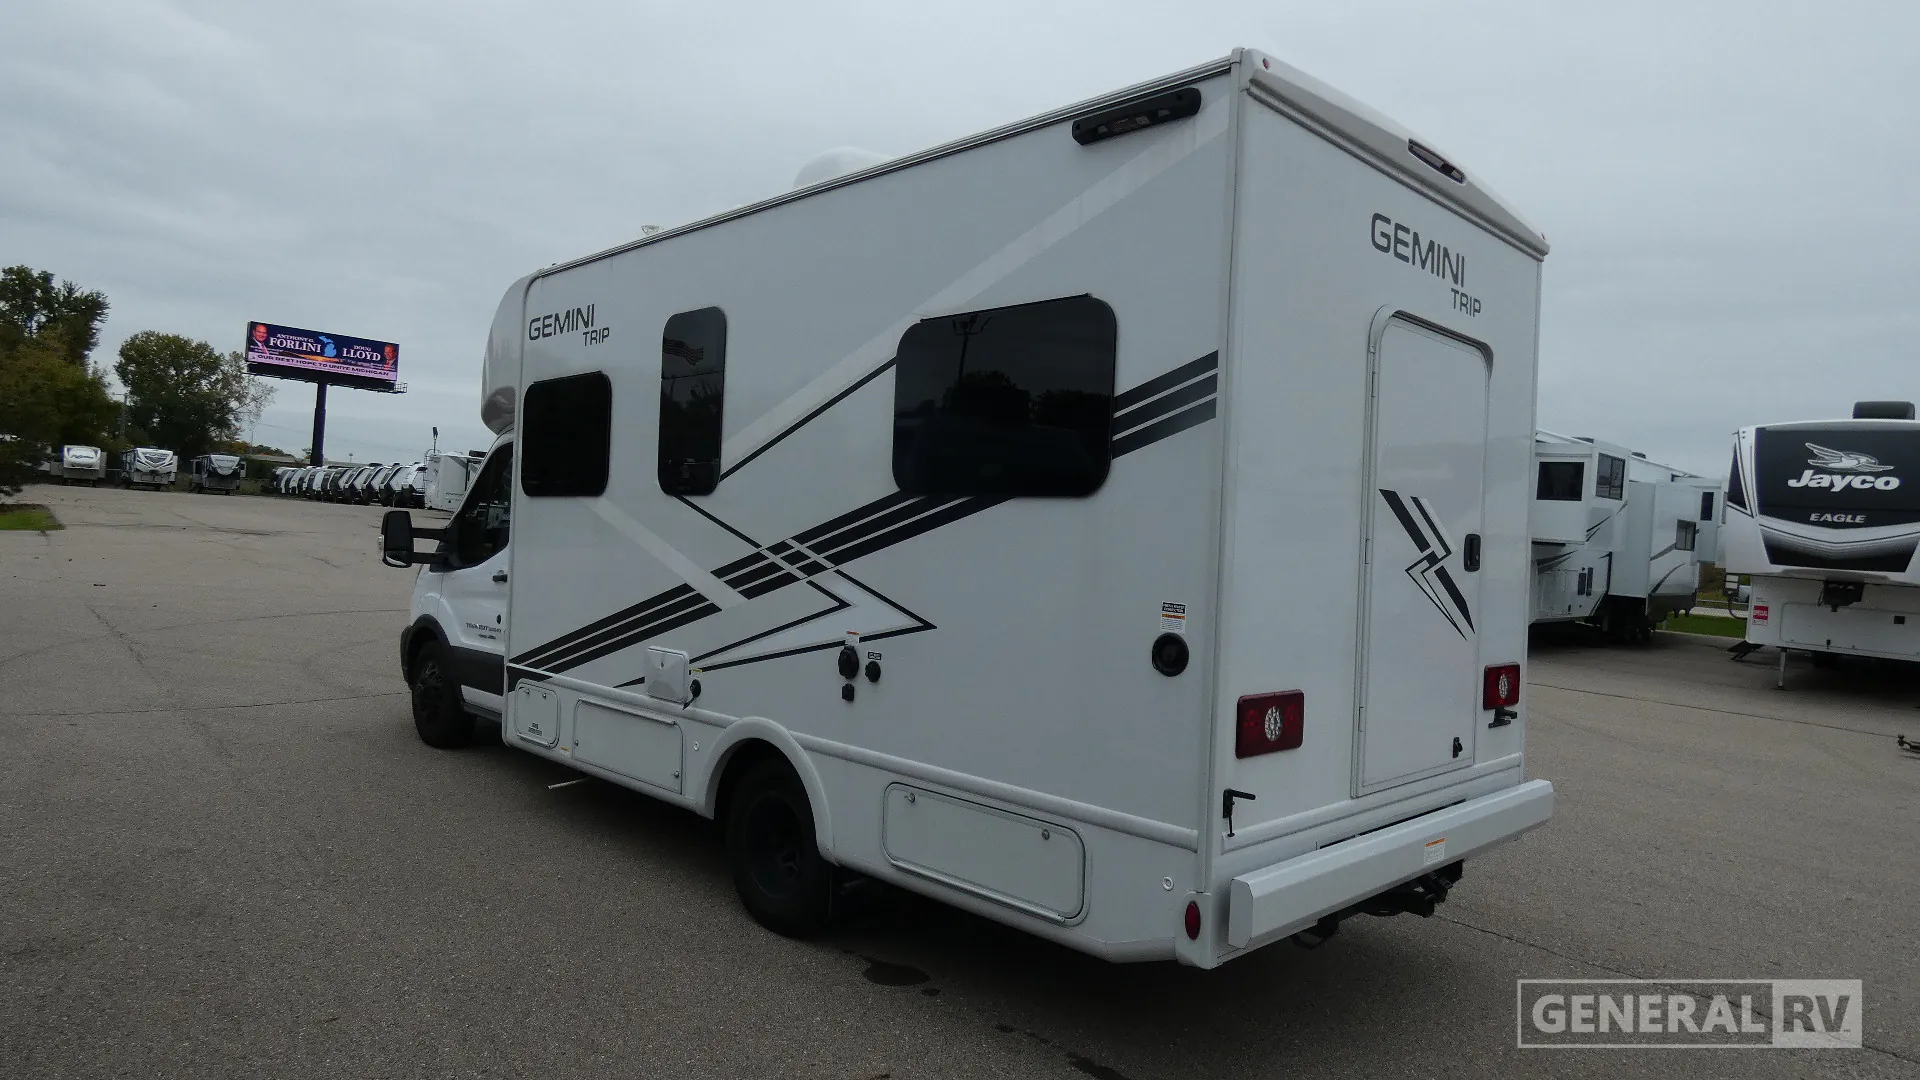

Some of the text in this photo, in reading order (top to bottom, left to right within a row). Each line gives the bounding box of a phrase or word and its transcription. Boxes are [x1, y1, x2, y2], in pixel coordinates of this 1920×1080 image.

[1371, 212, 1465, 288] GEMINI
[1451, 287, 1481, 317] TRIP
[529, 303, 595, 340] GEMINI
[269, 337, 322, 353] FORLINI
[583, 327, 609, 347] TRIP
[342, 347, 381, 361] LLOYD
[275, 356, 294, 364] BEST
[329, 363, 351, 371] UNITE
[351, 367, 389, 376] MICHIGAN
[1787, 469, 1900, 492] Jayco
[1809, 512, 1867, 524] EAGLE
